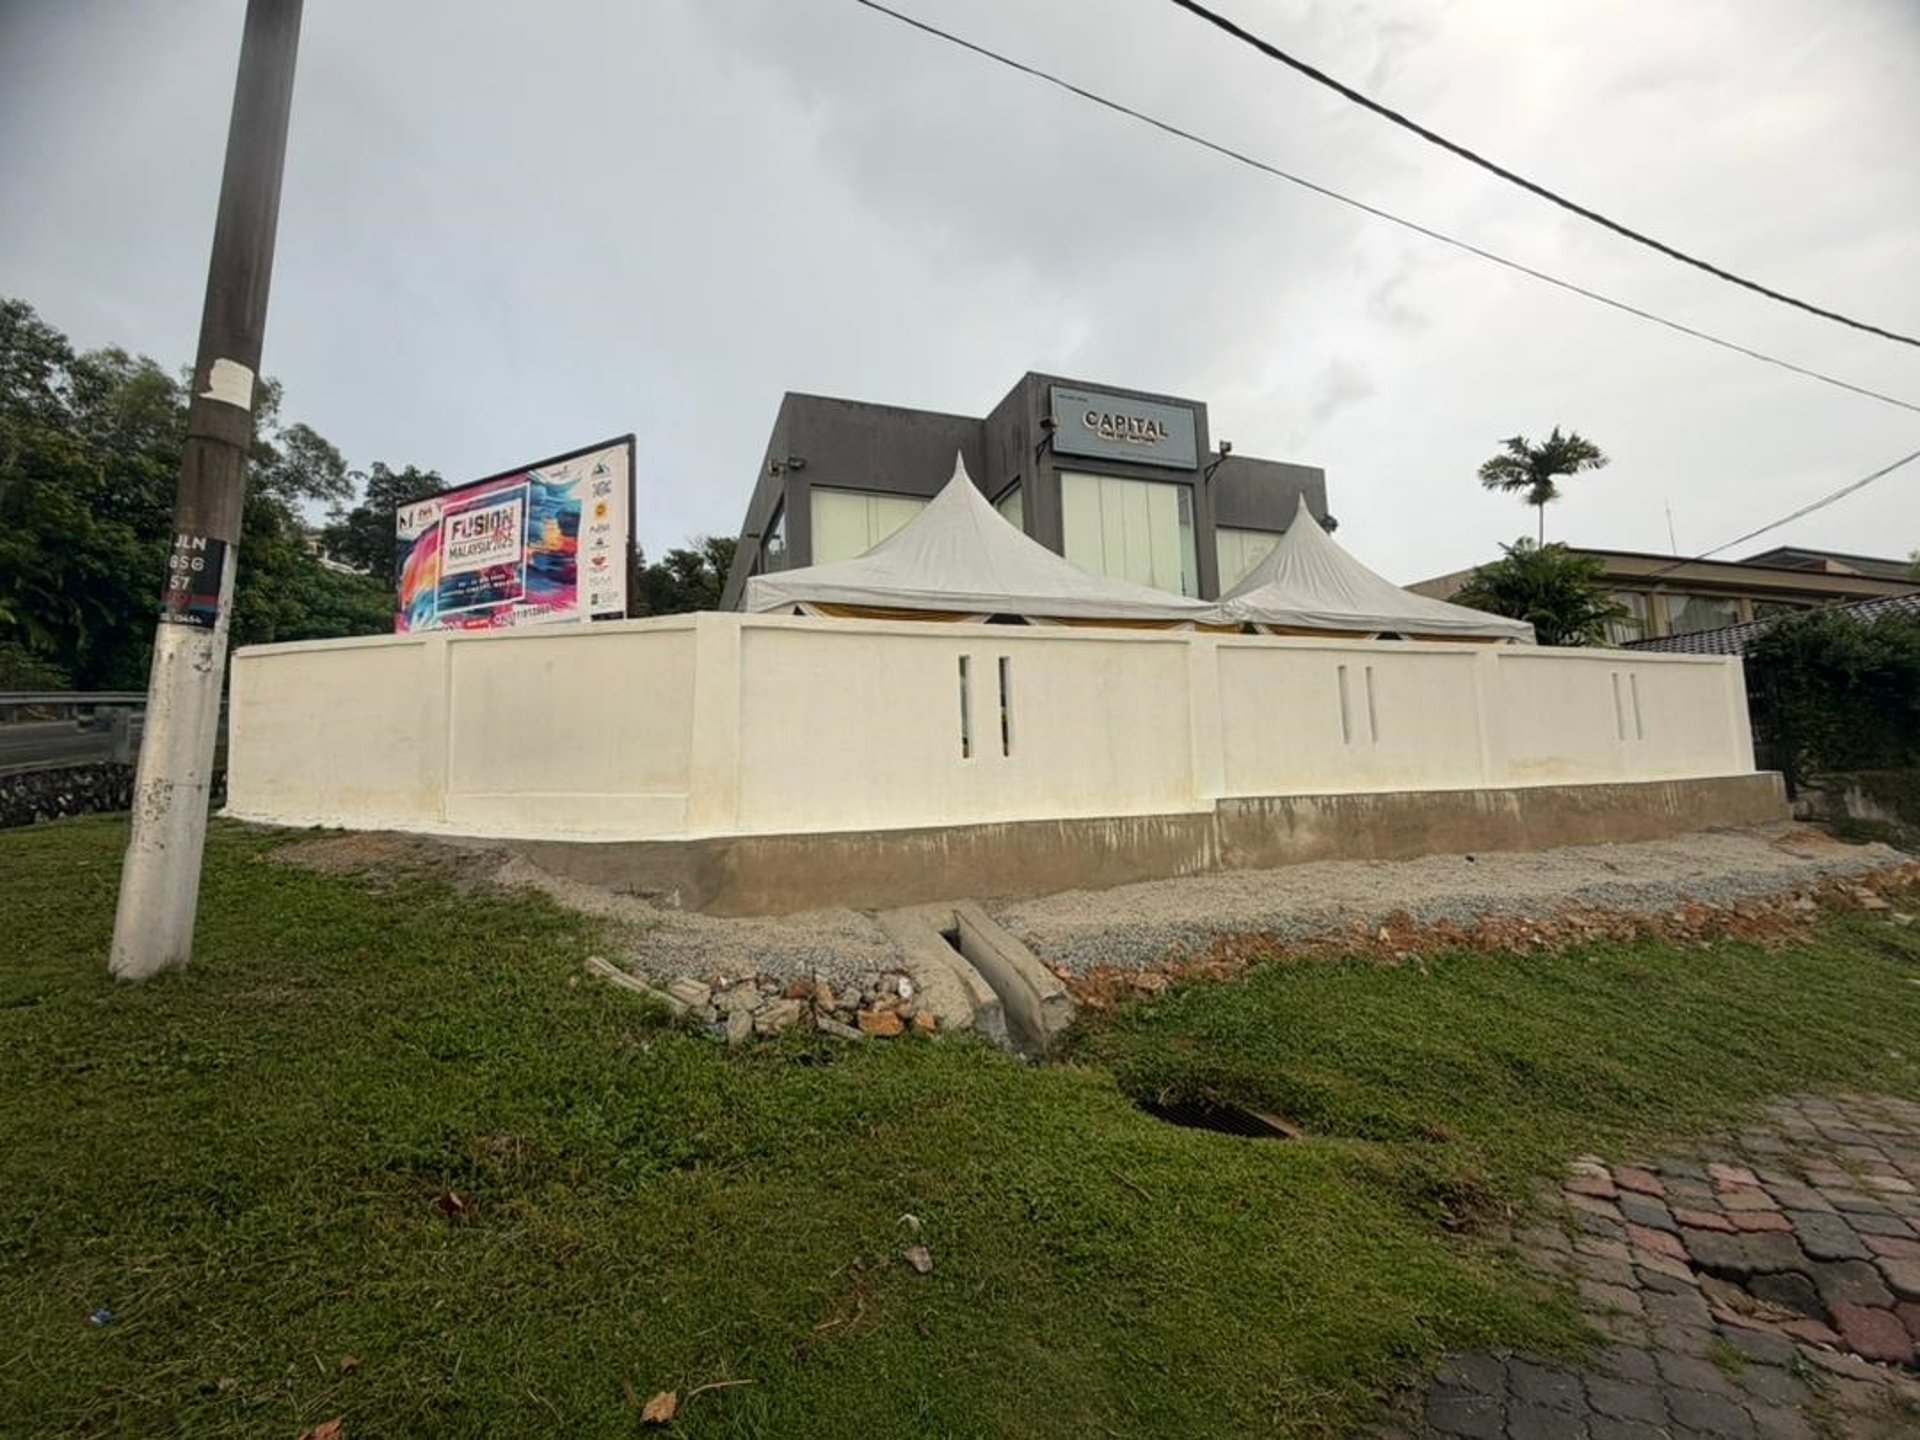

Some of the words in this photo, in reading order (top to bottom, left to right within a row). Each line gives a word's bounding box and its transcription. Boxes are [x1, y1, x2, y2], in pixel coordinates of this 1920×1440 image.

[1083, 411, 1169, 438] CAPITAL
[452, 507, 513, 541] FUSION
[175, 534, 207, 551] JLN
[449, 540, 493, 558] MALAYSIA
[170, 576, 190, 589] 57
